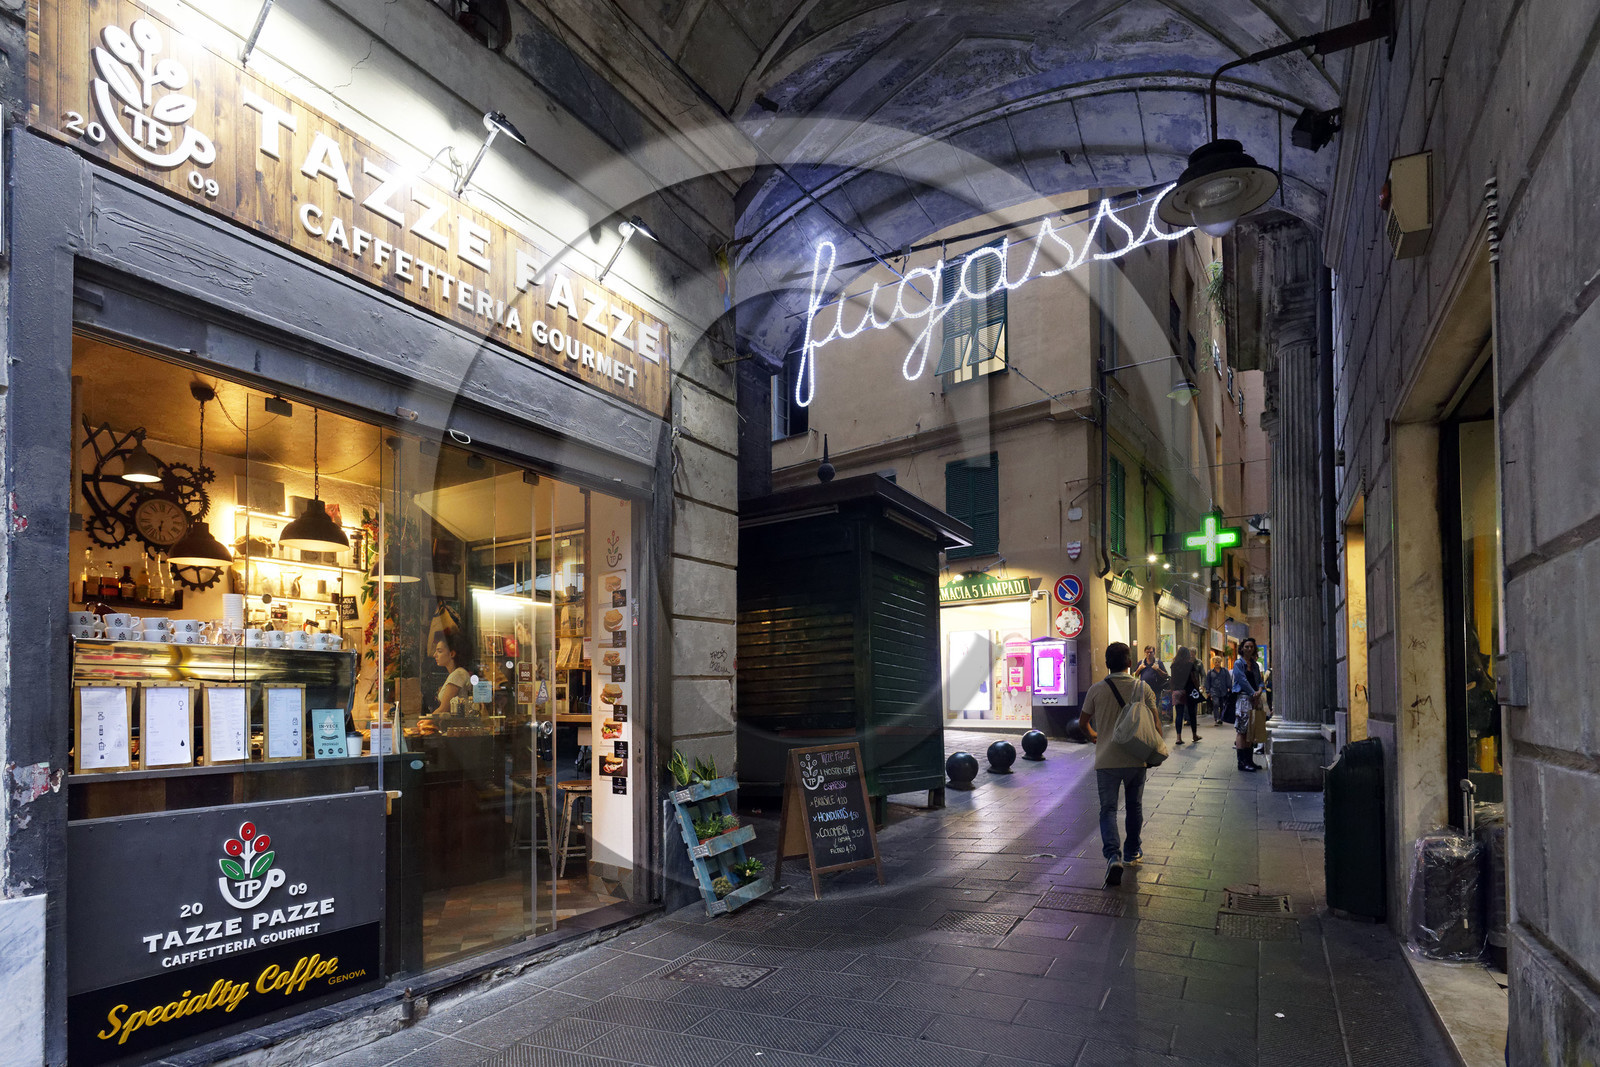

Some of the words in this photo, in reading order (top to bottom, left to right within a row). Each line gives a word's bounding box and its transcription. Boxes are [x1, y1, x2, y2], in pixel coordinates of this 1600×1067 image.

[63, 111, 106, 142] 20
[188, 171, 219, 198] 09
[242, 87, 491, 275] TAZZE
[515, 249, 661, 366] PAZZE
[300, 203, 523, 334] CAFFETTERIA
[531, 320, 638, 389] GOURMET
[939, 585, 972, 601] MACIA
[972, 585, 979, 598] 5
[979, 580, 1027, 597] LAMPADI
[234, 879, 262, 900] TP
[288, 883, 308, 896] 09
[180, 902, 203, 918] 20
[142, 917, 243, 953] TAZZE
[252, 898, 335, 930] PAZZE
[162, 938, 257, 968] CAFFETTERIA
[260, 922, 321, 944] GOURMET
[328, 969, 366, 986] GENOVA
[97, 979, 250, 1045] Specialty
[255, 953, 339, 995] Coffee
